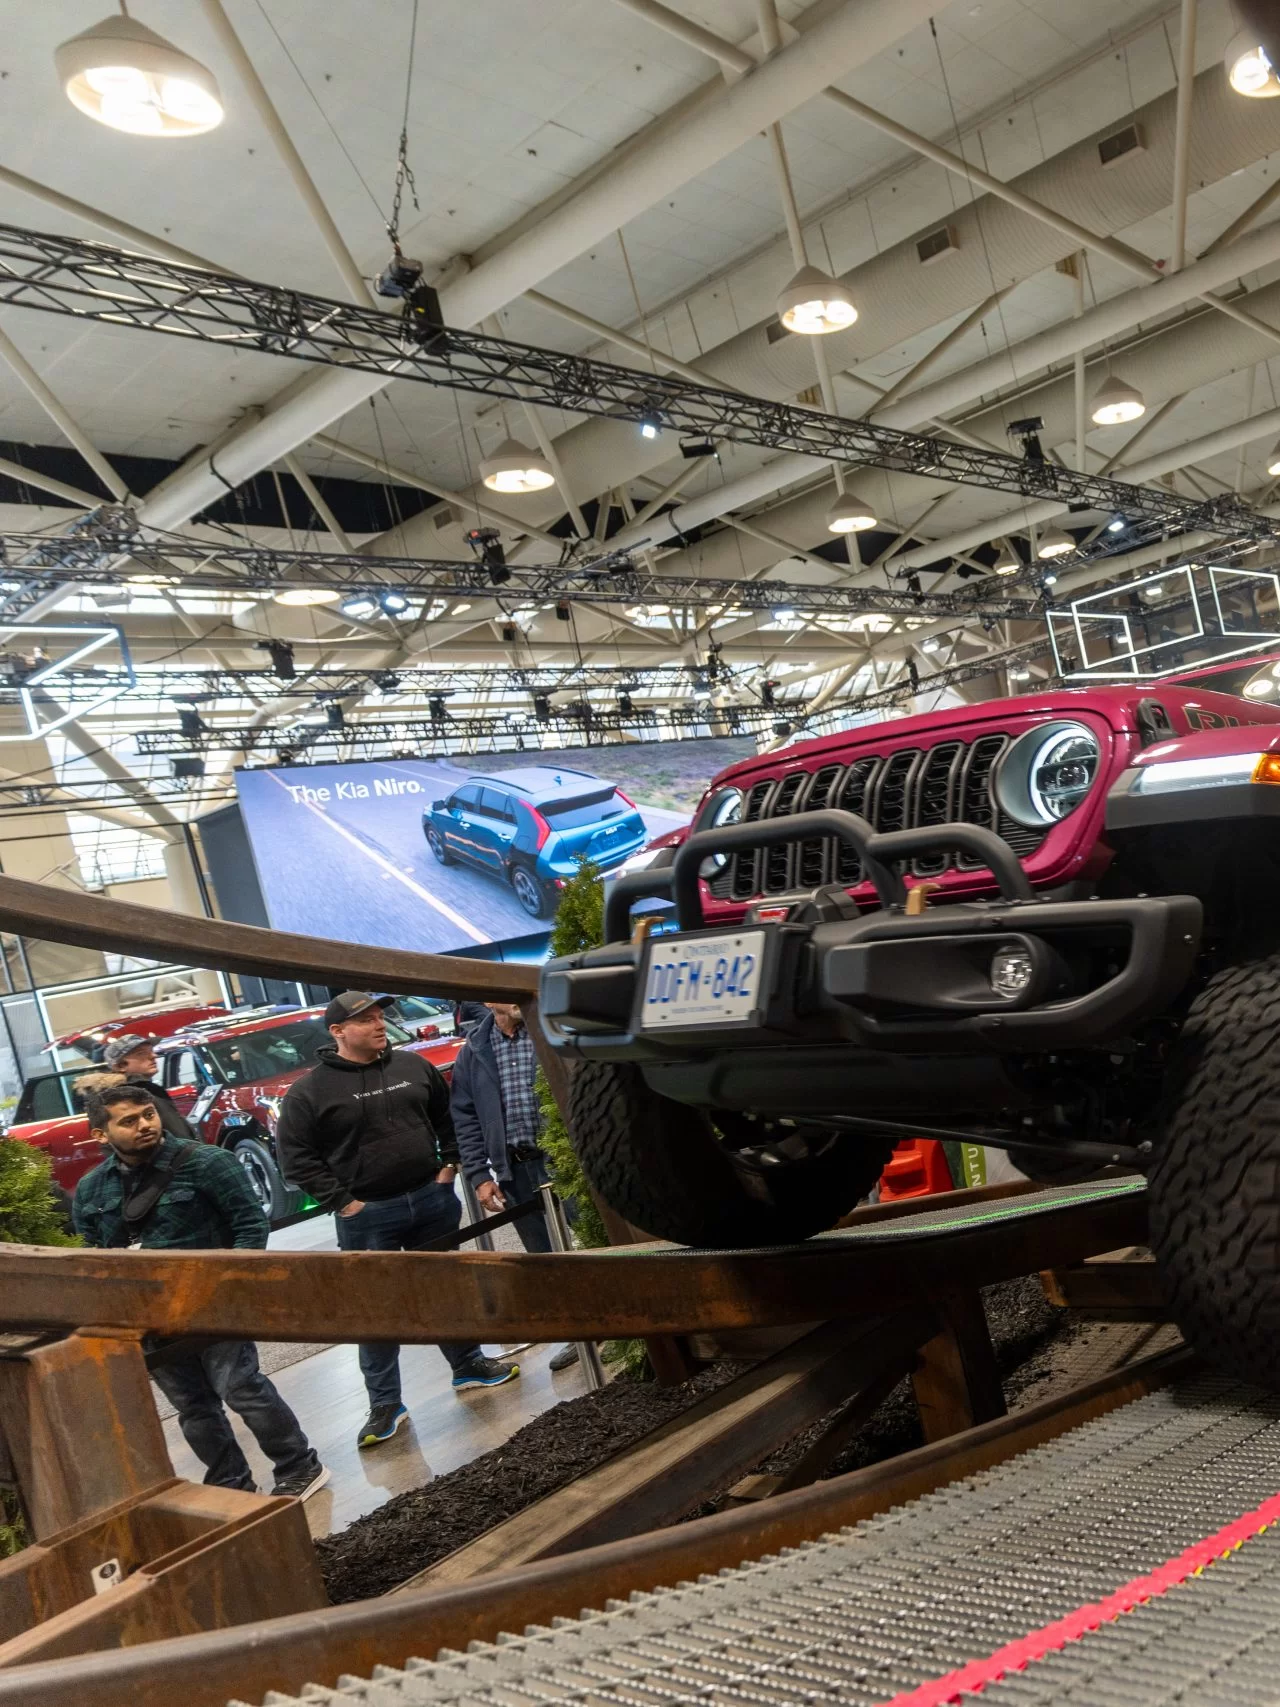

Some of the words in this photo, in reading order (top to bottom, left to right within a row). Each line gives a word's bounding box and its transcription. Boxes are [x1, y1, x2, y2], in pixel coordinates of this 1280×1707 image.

[287, 785, 331, 804] The
[335, 782, 369, 800] Kia
[373, 778, 425, 796] Niro.
